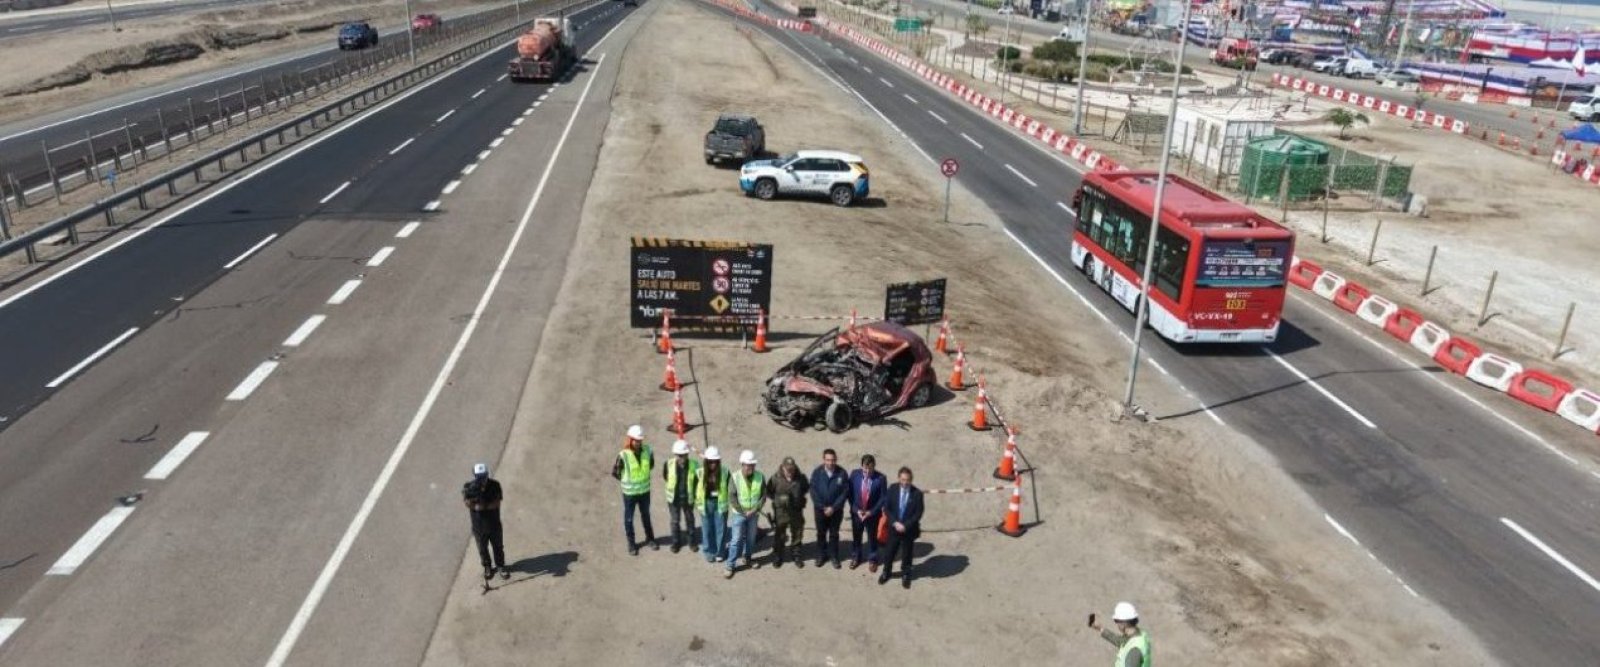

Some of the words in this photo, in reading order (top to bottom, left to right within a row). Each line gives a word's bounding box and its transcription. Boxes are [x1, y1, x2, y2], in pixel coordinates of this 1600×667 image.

[637, 269, 656, 279] ESTE
[656, 270, 676, 280] AUTO
[672, 280, 701, 291] MARTES
[637, 289, 644, 299] A
[644, 289, 657, 300] LAS
